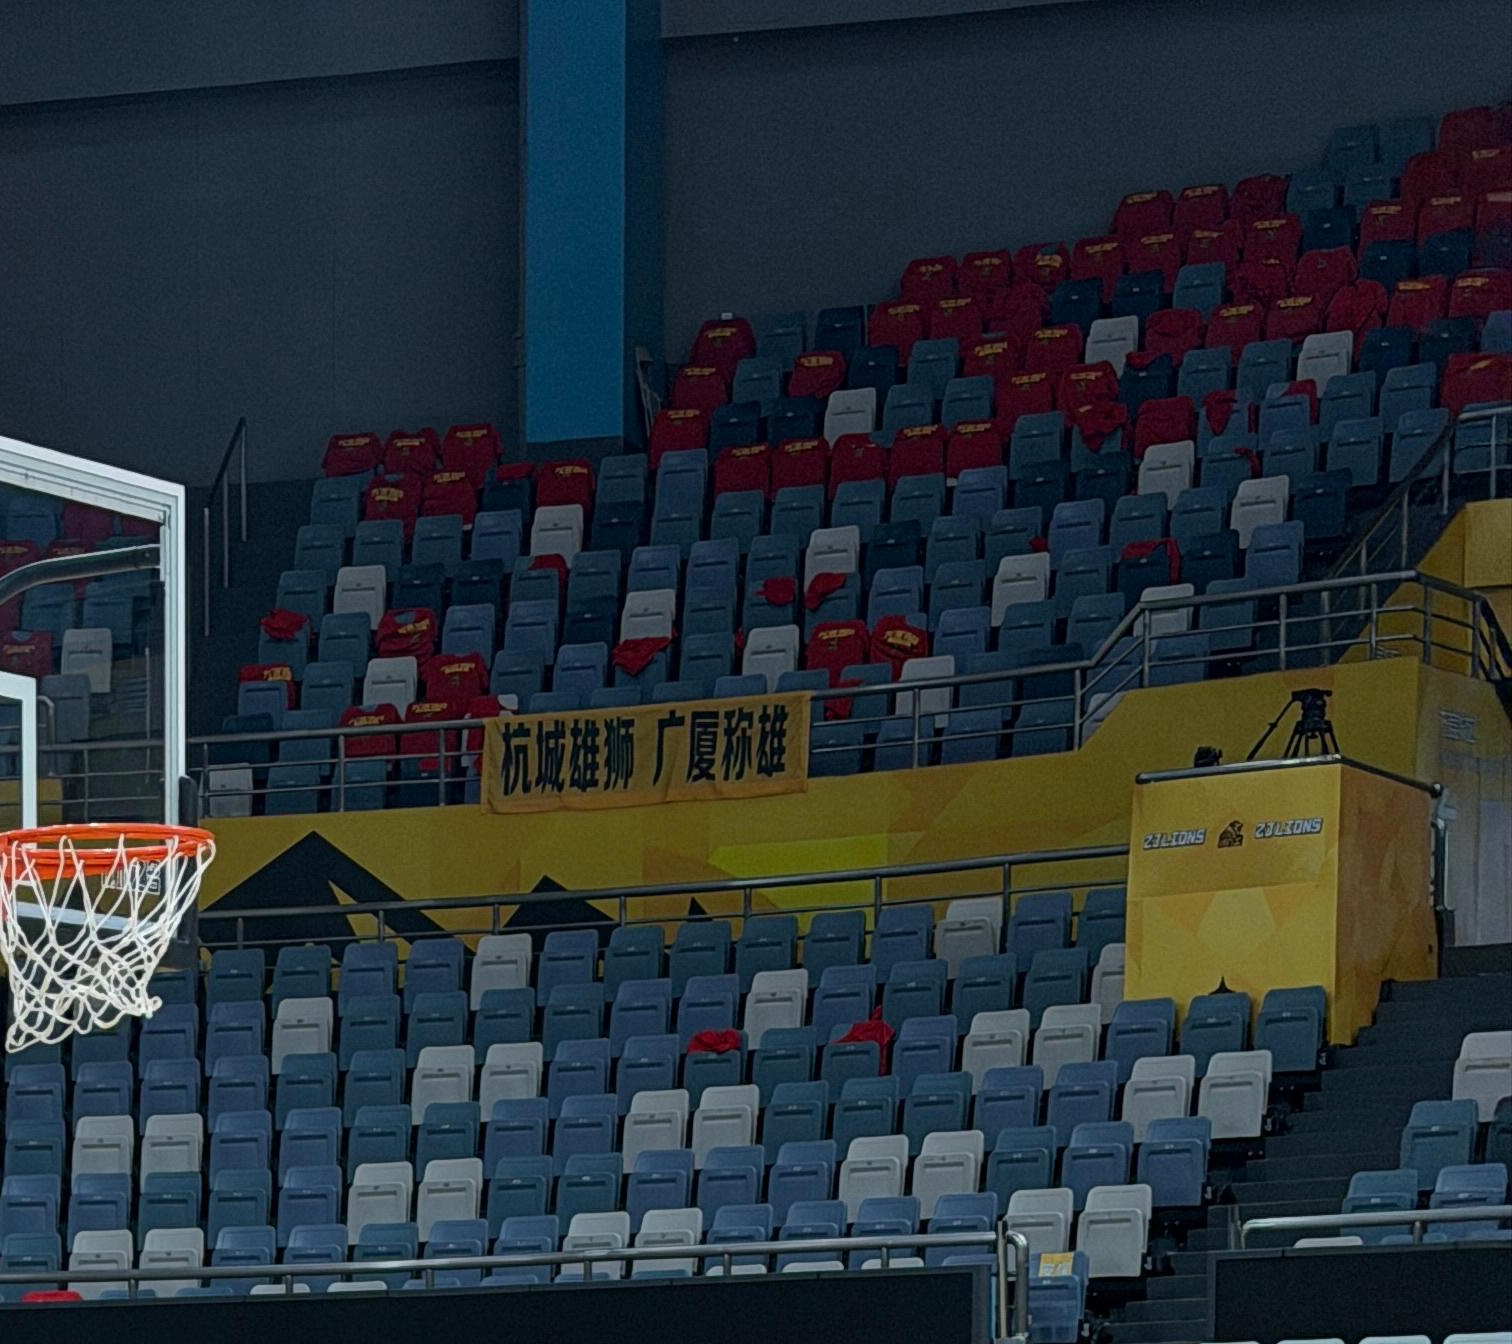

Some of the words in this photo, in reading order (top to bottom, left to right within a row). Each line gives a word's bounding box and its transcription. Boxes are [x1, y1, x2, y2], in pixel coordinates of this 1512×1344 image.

[501, 717, 635, 795] 杭城雄狮
[652, 704, 789, 787] 广厦称雄
